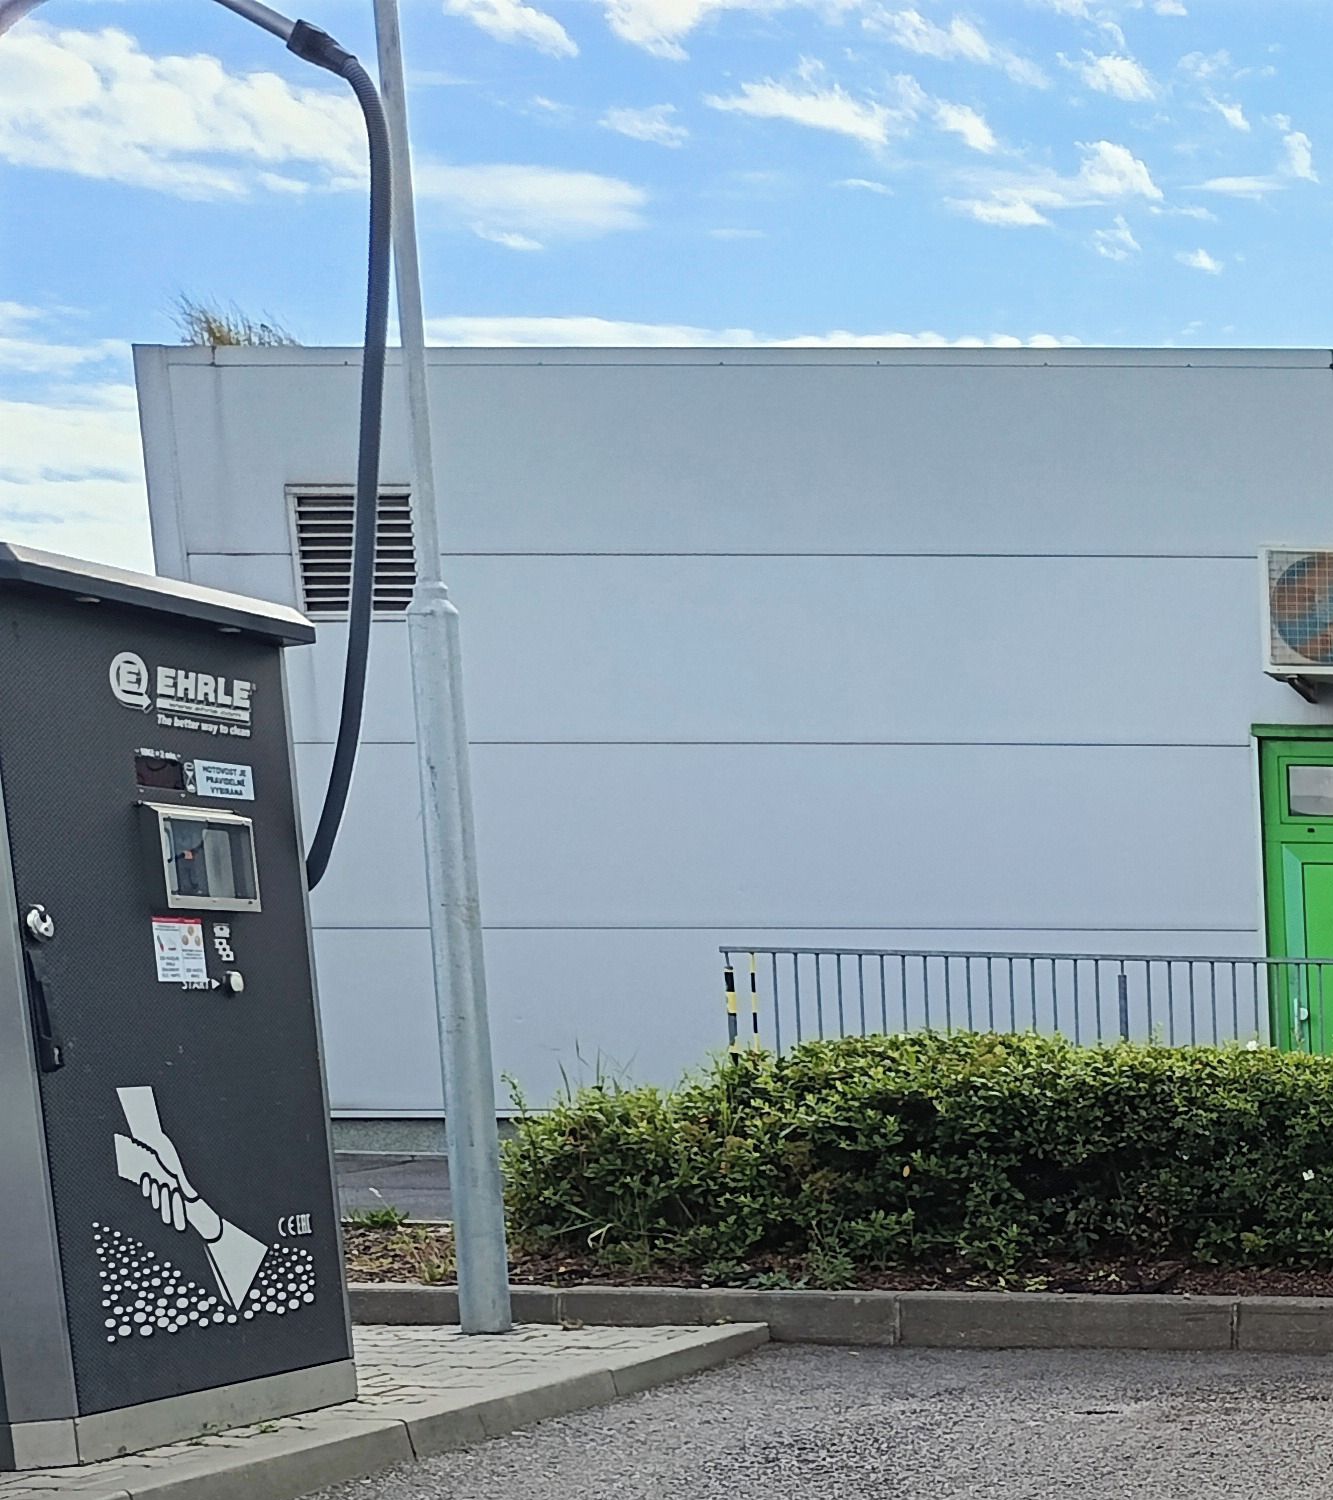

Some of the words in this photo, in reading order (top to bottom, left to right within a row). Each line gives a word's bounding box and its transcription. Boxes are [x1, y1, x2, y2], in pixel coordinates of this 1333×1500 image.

[156, 666, 251, 709] EHRLE
[156, 714, 173, 726] The
[174, 716, 200, 730] better
[201, 724, 218, 735] way
[219, 725, 229, 734] to
